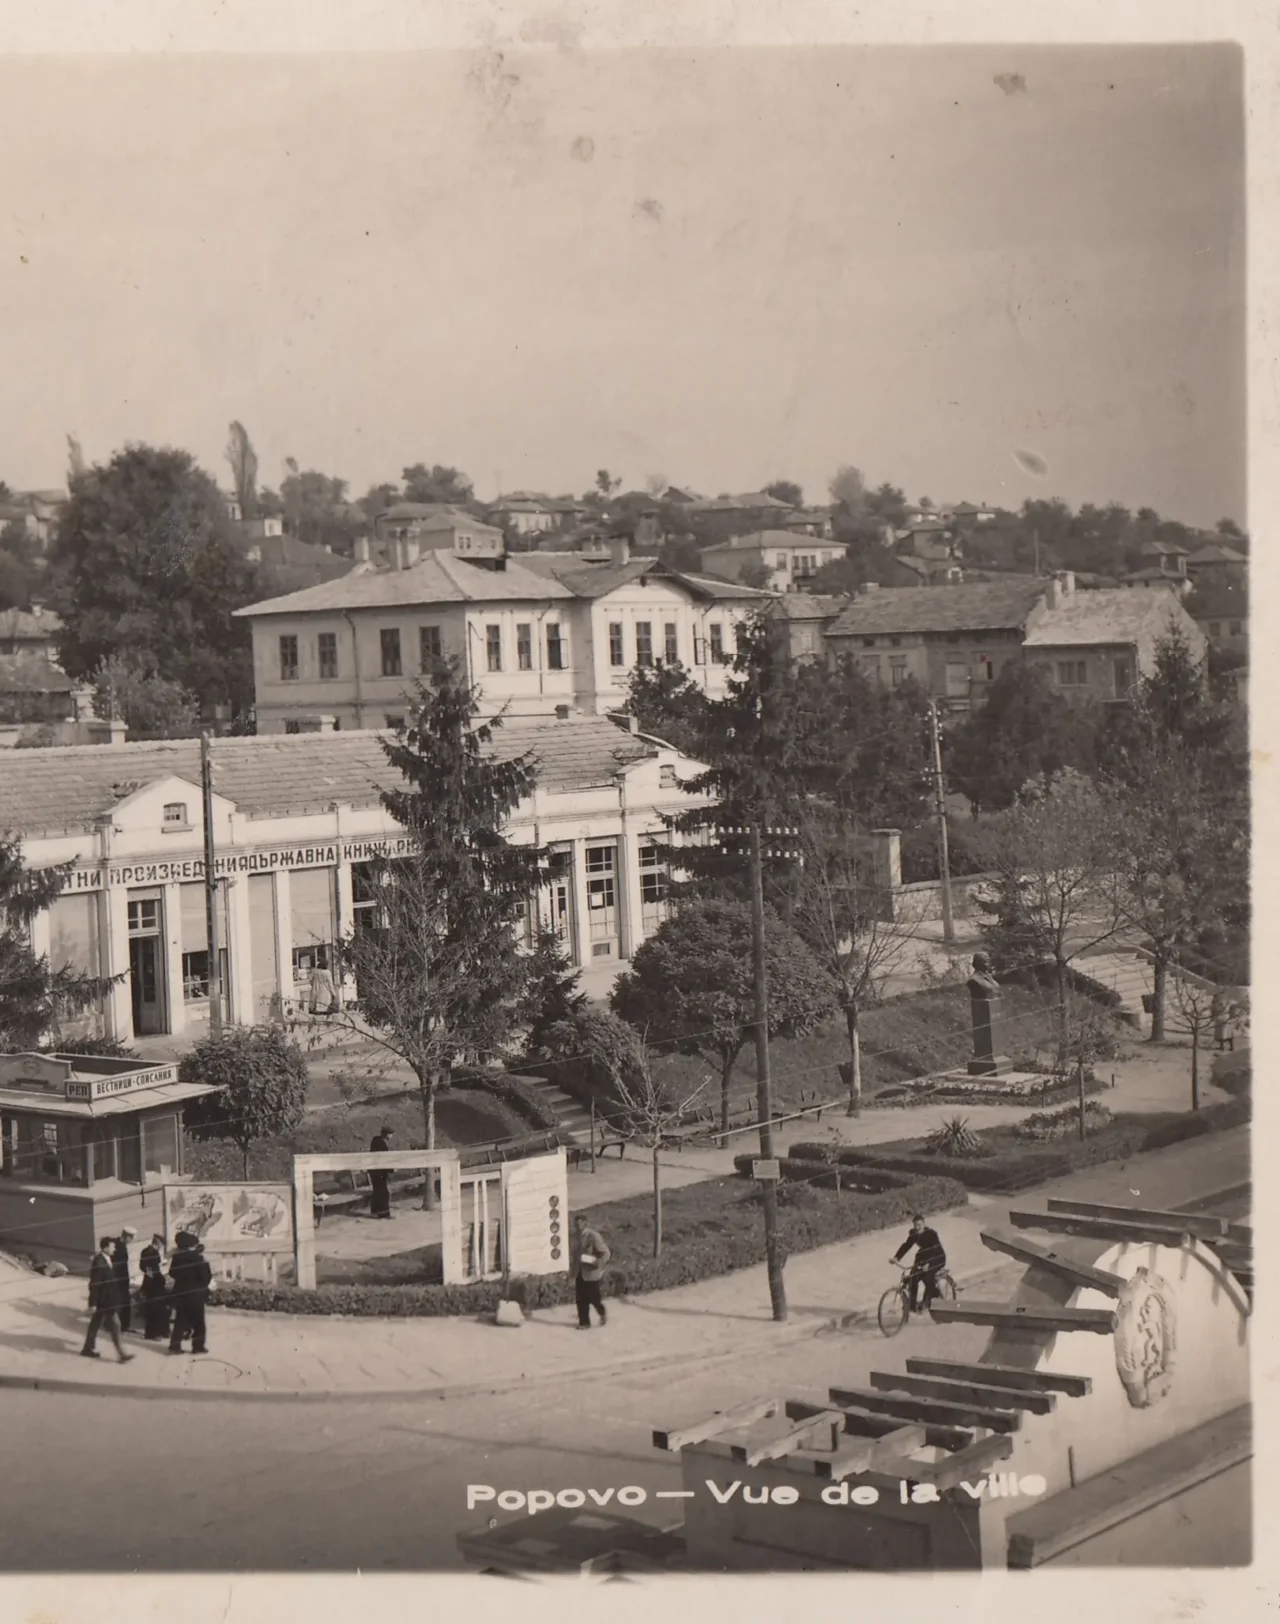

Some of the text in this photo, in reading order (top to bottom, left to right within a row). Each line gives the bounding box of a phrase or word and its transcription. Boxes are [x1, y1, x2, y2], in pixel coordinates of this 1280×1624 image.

[109, 855, 249, 885] ПРОИЗВЕДНИЯ
[248, 847, 335, 871] ДЪРЖАВНА
[97, 1069, 172, 1094] ВЕСТНИЦИ СПИСАНИЯ
